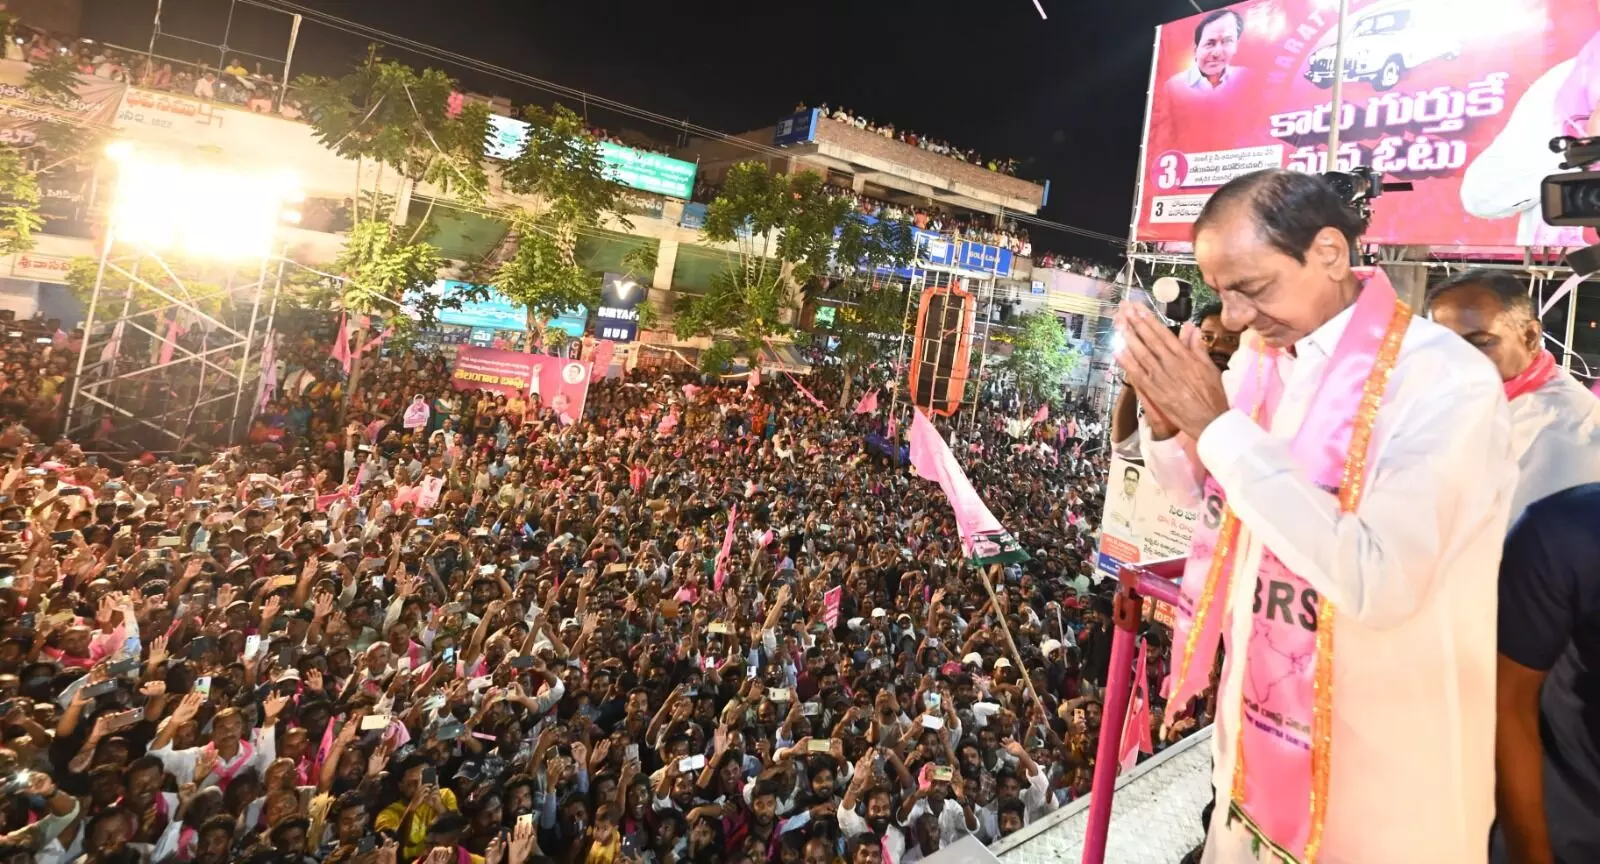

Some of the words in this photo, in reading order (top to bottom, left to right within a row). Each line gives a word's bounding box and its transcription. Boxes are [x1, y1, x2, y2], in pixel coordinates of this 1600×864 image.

[1269, 100, 1356, 138] కారు
[1364, 72, 1509, 133] గుర్తుకే
[1287, 141, 1362, 177] మన
[1371, 135, 1467, 172] ఓటు
[1155, 202, 1164, 217] 3
[603, 328, 628, 340] HUB
